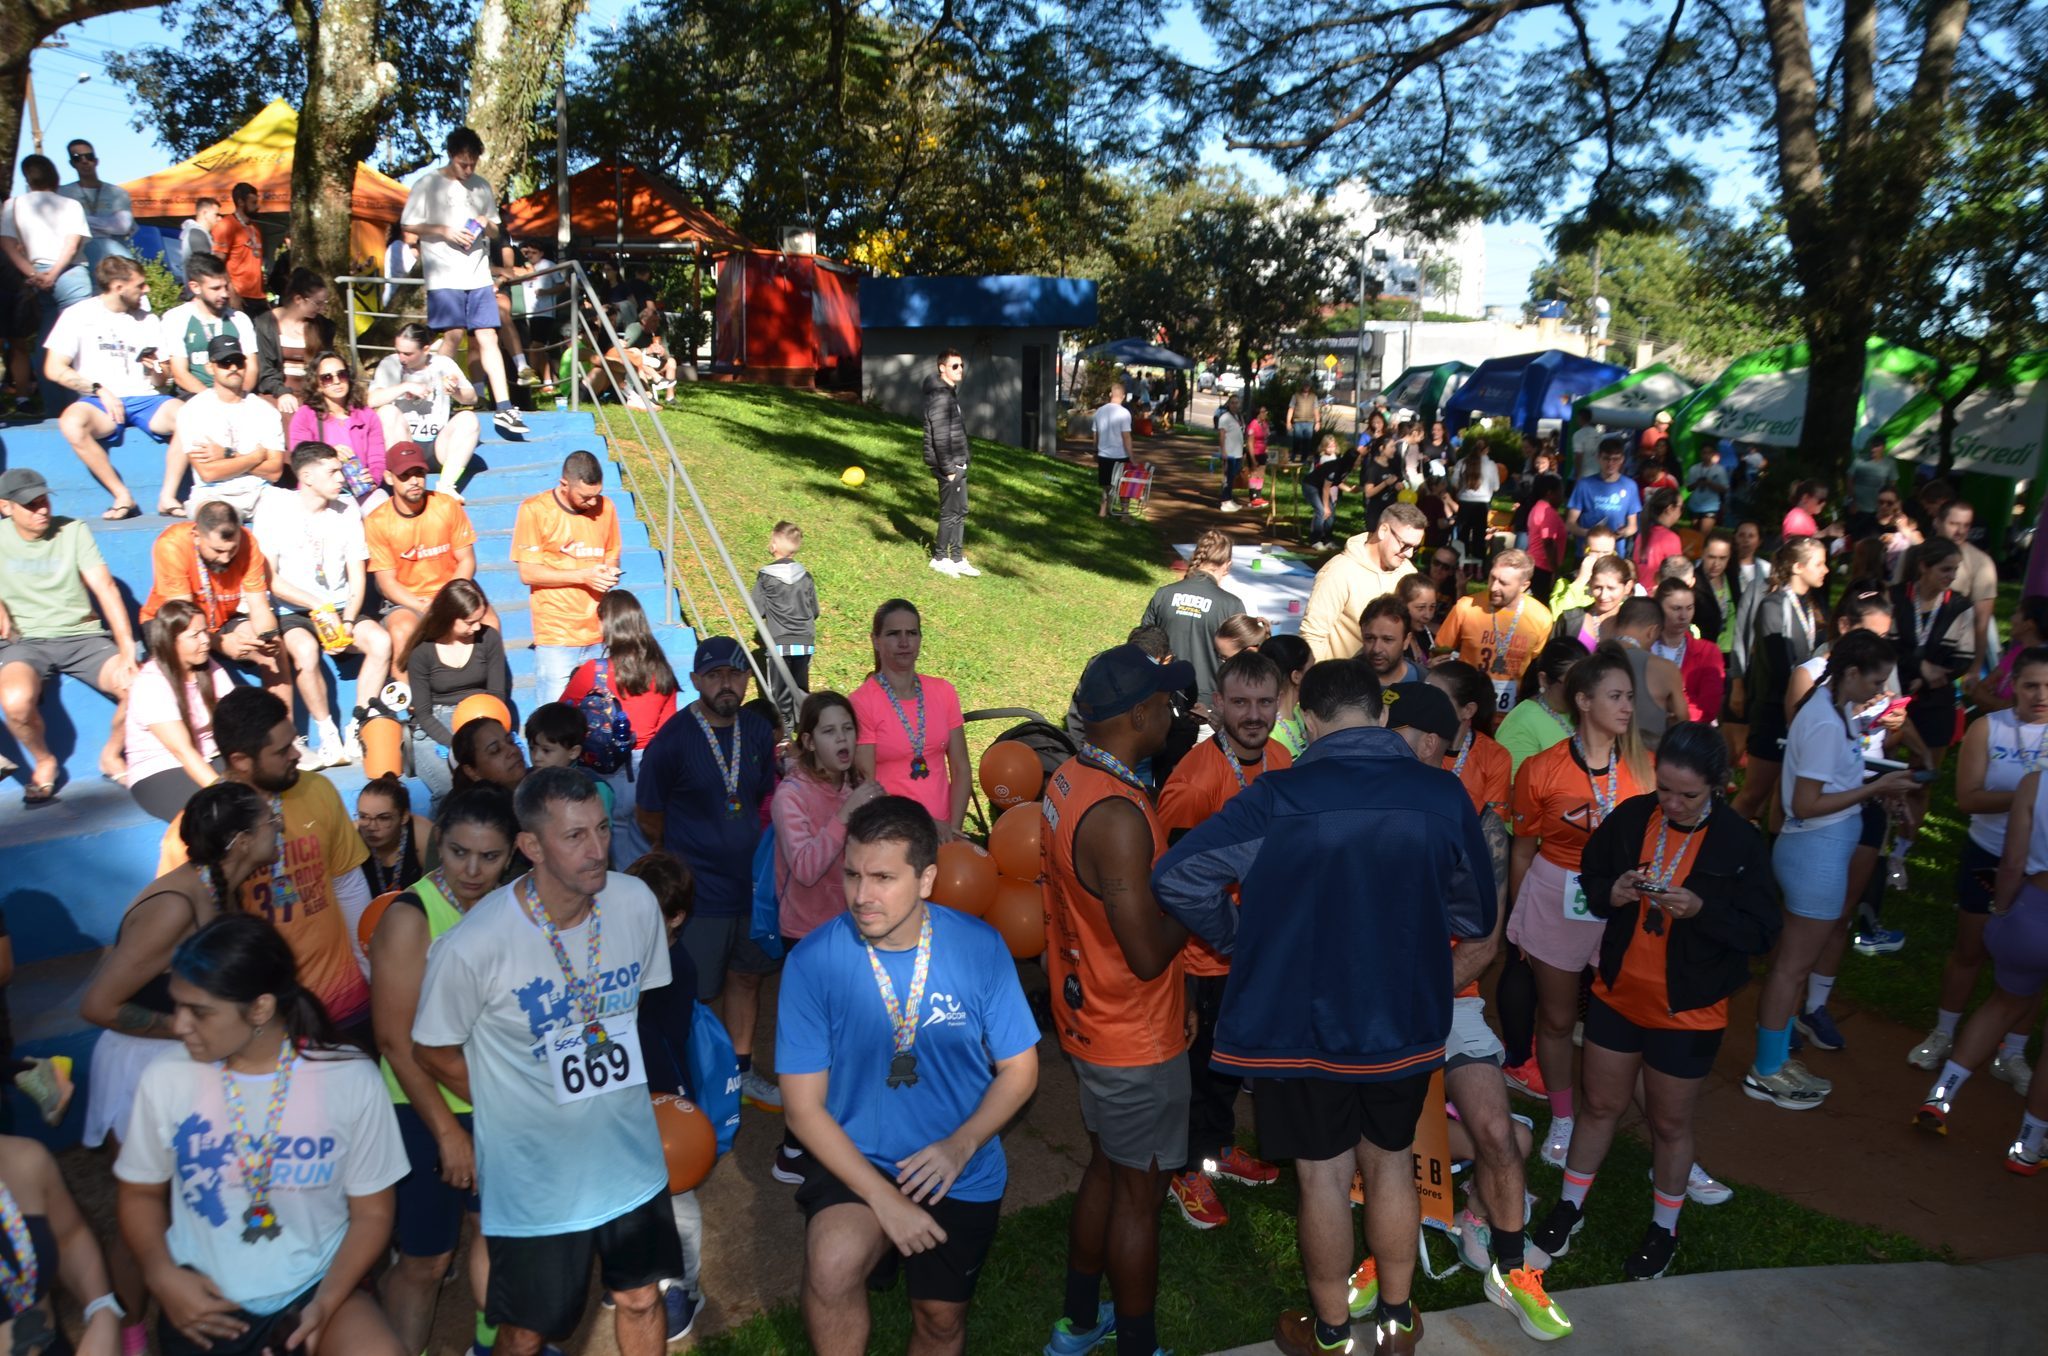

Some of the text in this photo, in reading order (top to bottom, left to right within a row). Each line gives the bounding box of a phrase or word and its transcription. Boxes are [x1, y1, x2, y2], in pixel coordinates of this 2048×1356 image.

[409, 424, 439, 436] 746
[1739, 415, 1803, 437] Sicredi
[1949, 435, 2035, 467] Sicredi
[1171, 593, 1213, 613] RODEIO
[562, 1043, 630, 1094] 669
